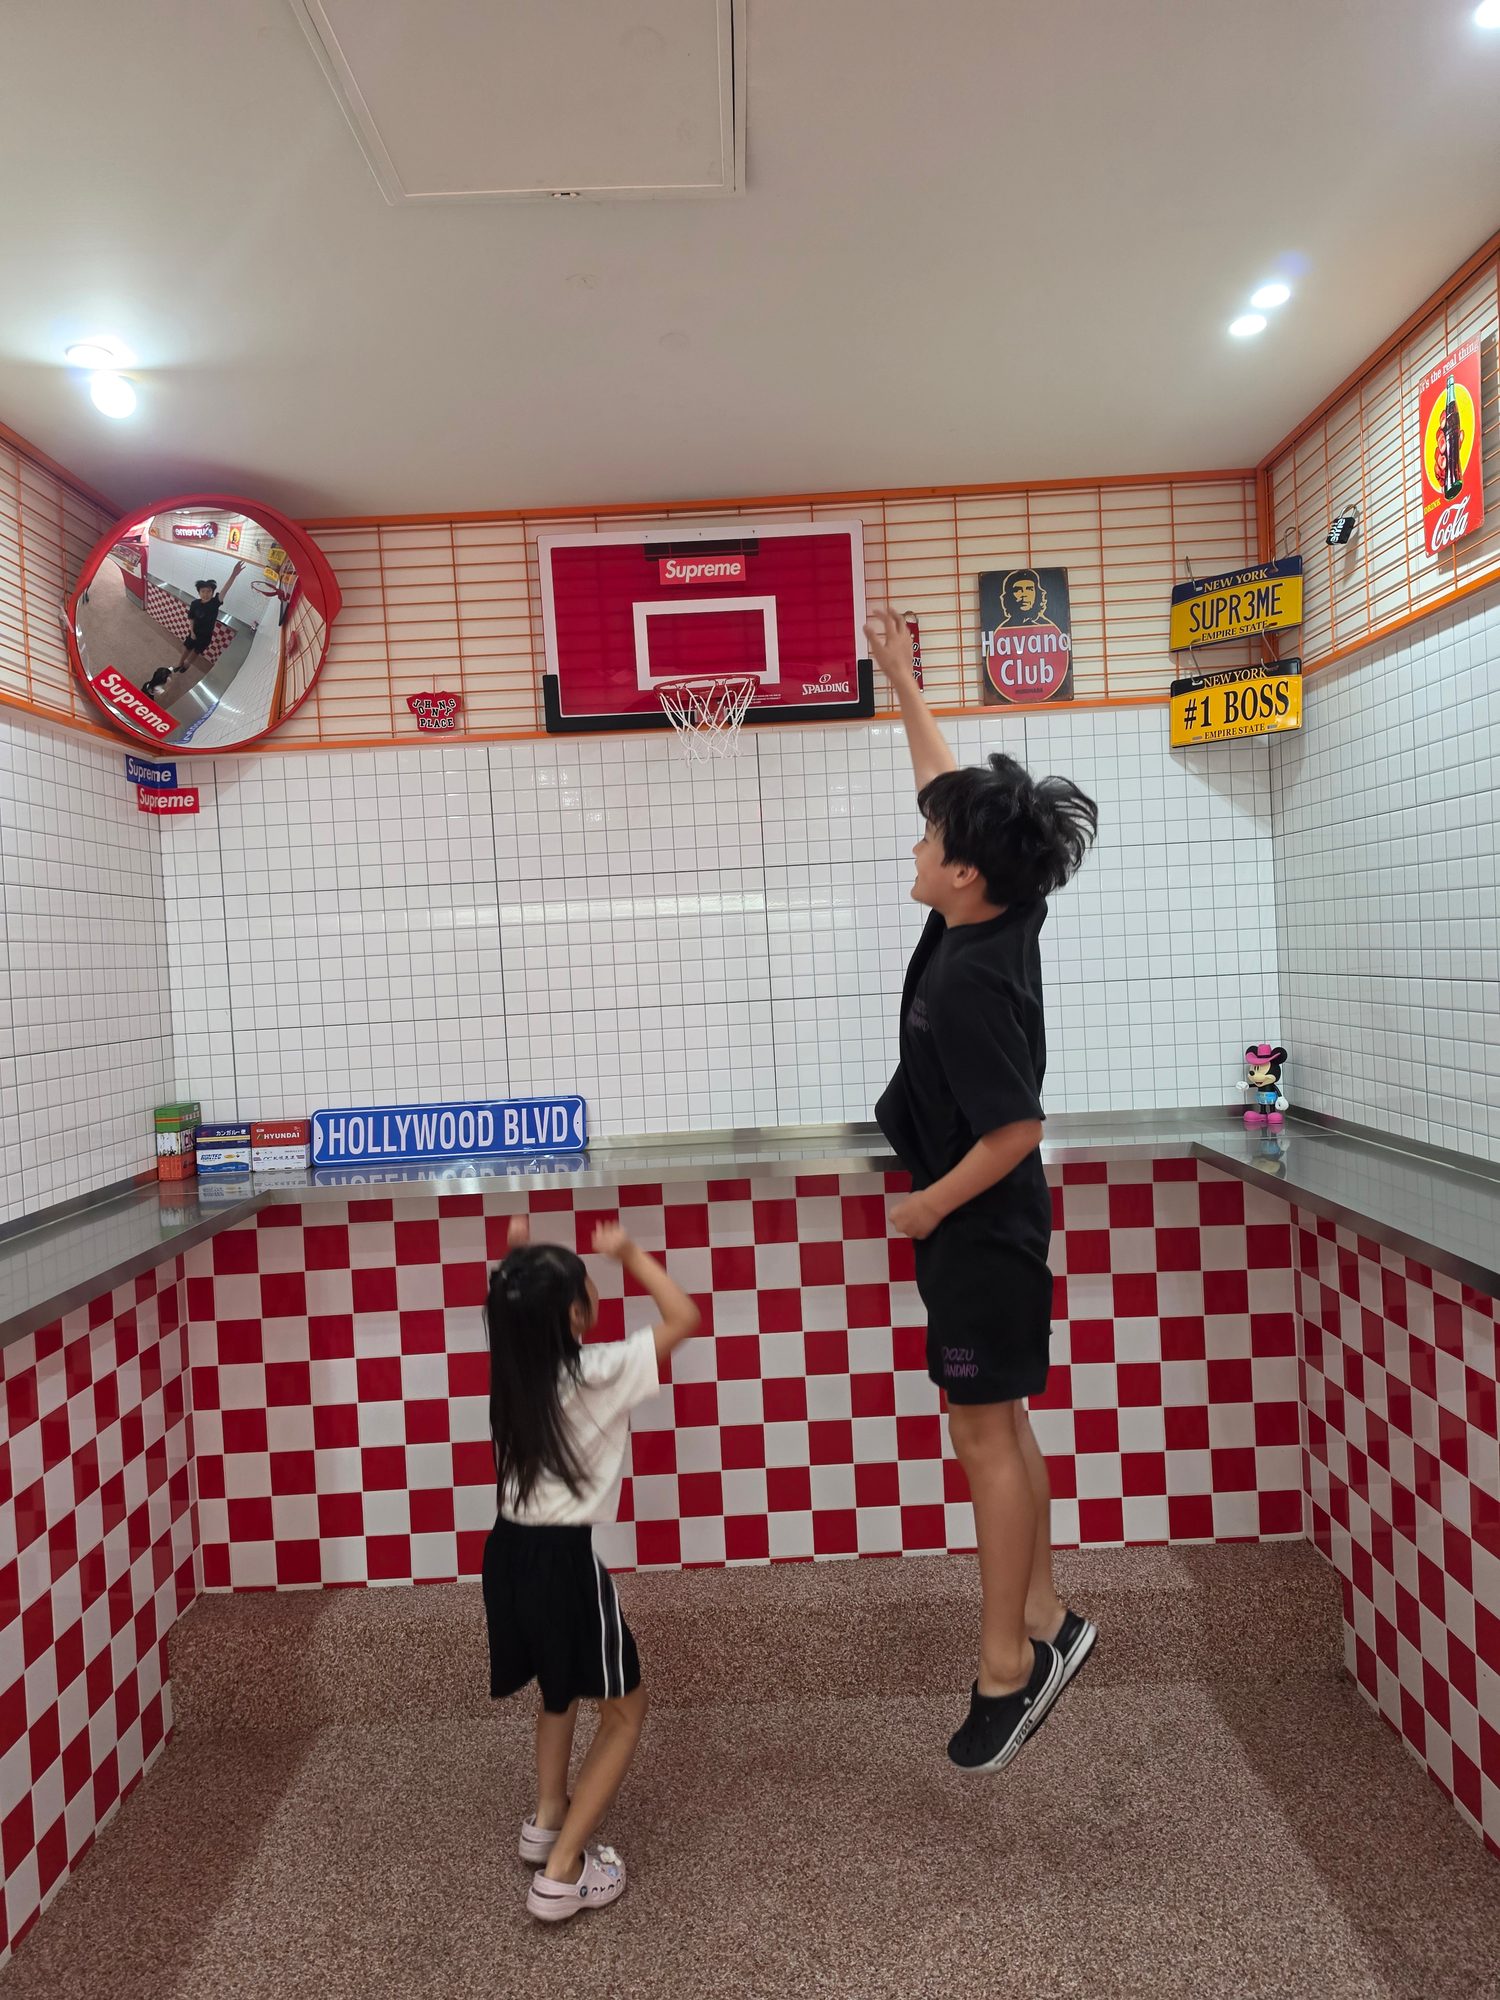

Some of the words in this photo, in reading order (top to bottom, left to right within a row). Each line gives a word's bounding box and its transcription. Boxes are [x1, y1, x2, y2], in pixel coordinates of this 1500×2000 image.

[1430, 369, 1442, 385] the
[1442, 354, 1457, 374] real
[1431, 493, 1471, 551] Cola
[665, 559, 741, 583] Supreme
[1203, 576, 1233, 593] NEW
[1236, 567, 1268, 584] YORK
[1189, 583, 1283, 633] SUPR3ME
[981, 630, 1071, 657] Havana
[1201, 627, 1237, 642] EMPIRE
[1240, 620, 1268, 633] STATE
[1000, 658, 1054, 686] Club
[1203, 673, 1233, 688] NEW
[1234, 667, 1268, 682] YORK
[802, 681, 850, 696] SPALDING
[100, 673, 171, 733] Supreme
[1184, 695, 1212, 730] #1
[1223, 681, 1289, 724] BOSS
[419, 717, 454, 728] PLACE
[1204, 727, 1237, 740] EMPIRE
[1238, 723, 1265, 734] STATE
[128, 757, 172, 783] Supreme
[139, 787, 195, 811] Supreme
[264, 1131, 300, 1140] HYUNDAI
[328, 1110, 494, 1156] HOLLYWOOD
[503, 1105, 568, 1146] BLVD
